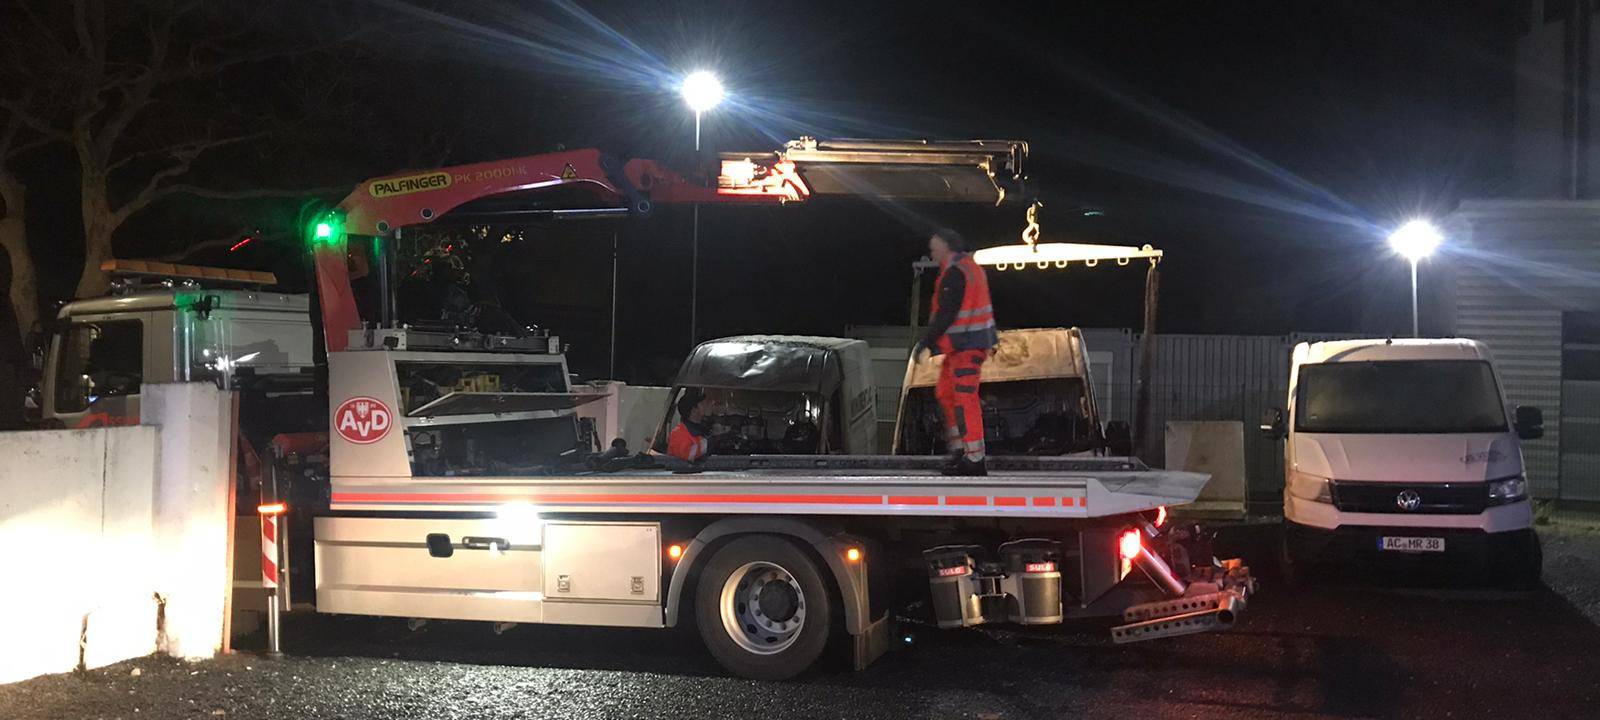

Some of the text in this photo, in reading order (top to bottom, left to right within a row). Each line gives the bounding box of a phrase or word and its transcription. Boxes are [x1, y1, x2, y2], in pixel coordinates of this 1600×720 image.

[455, 173, 471, 184] PK
[374, 175, 447, 195] PALFINGER
[1387, 538, 1440, 550] AC MR 38
